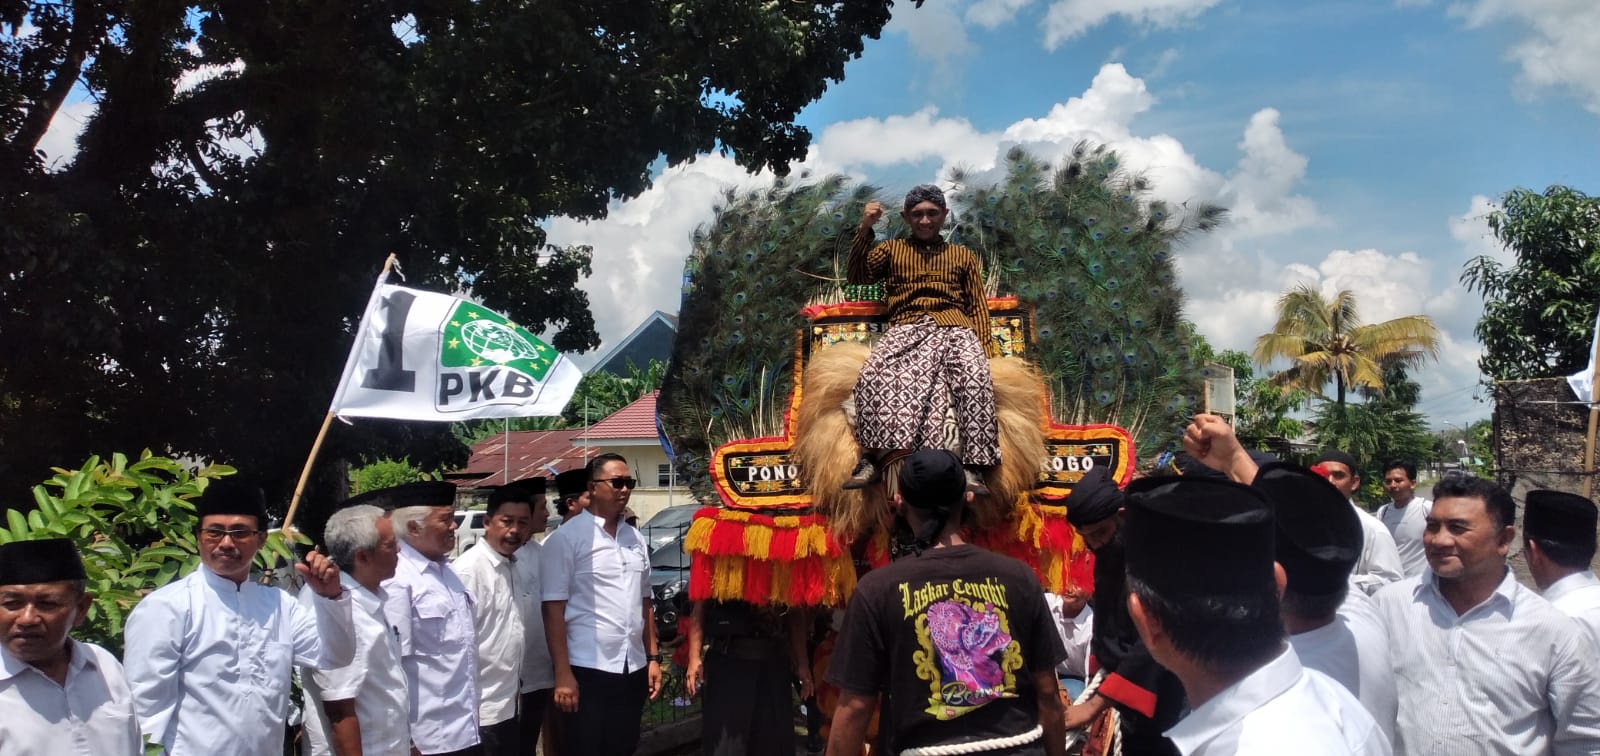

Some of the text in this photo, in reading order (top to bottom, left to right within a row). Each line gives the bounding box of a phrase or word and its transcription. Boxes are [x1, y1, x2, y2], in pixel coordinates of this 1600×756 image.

[361, 290, 416, 392] 1
[439, 370, 534, 406] PKB
[748, 465, 798, 481] PONO
[899, 581, 949, 620] Laskar
